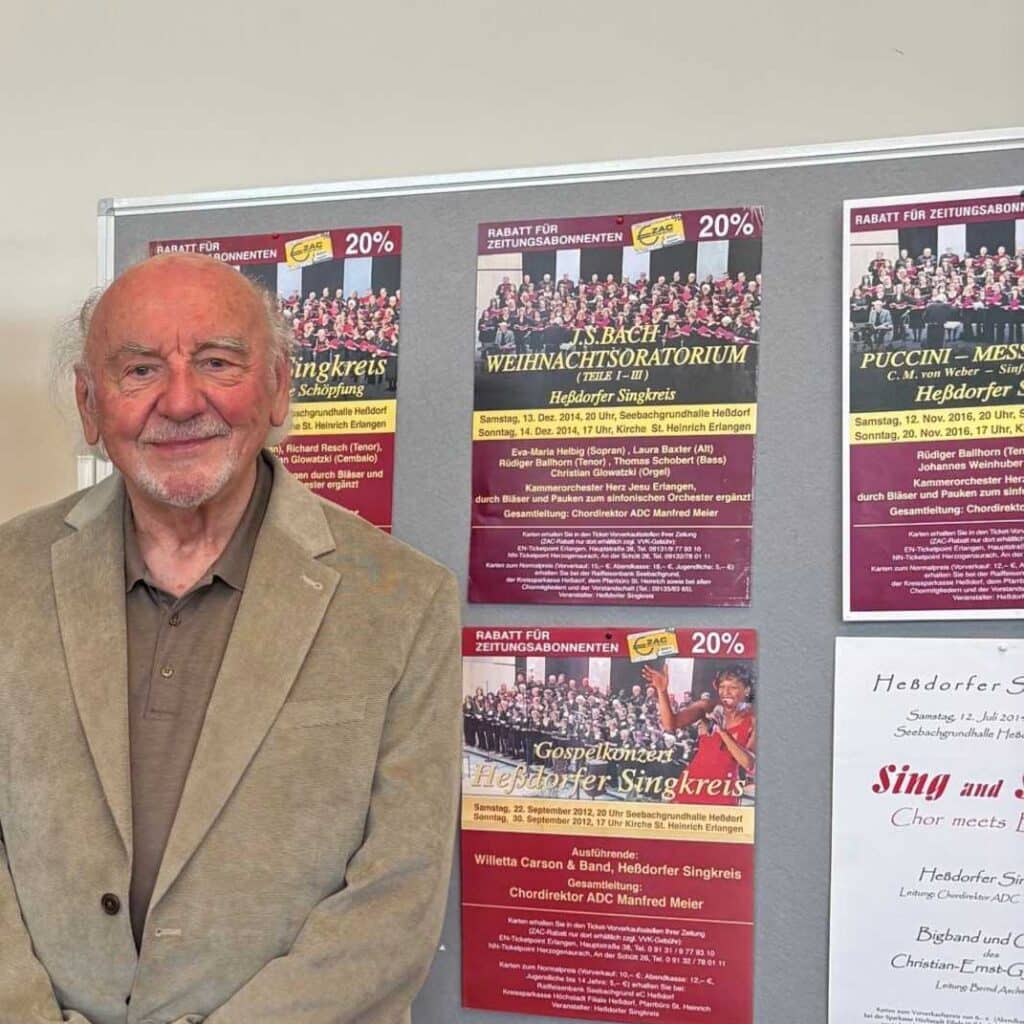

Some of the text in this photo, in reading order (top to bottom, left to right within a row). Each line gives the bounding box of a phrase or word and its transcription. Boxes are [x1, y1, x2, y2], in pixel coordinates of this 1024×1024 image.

[855, 201, 1024, 225] RABATT FÜR ZEITUNGSABONN
[488, 222, 558, 239] RABATT FÜR
[699, 213, 754, 238] 20%
[199, 241, 220, 251] FÜR
[345, 231, 394, 255] 20%
[487, 232, 623, 249] ZEITUNGSABONNENTEN
[213, 249, 276, 263] ABONNENTEN
[486, 346, 748, 372] WEIHNACHTSORATORIUM
[860, 344, 1024, 369] PUCCINI MESS
[290, 354, 387, 381] ingkreis
[945, 368, 980, 377] Weber
[298, 383, 365, 399] Schöpfung
[549, 388, 676, 406] Heßdorfer Singkreis
[916, 382, 1012, 405] Heßdorfer
[480, 414, 520, 425] Samstag,
[586, 412, 596, 420] 20
[619, 409, 710, 422] Seebachgrundhalle
[712, 408, 750, 418] Heßdorf
[855, 417, 902, 427] Samstag,
[923, 414, 946, 424] Nov.
[979, 411, 992, 420] 20
[478, 428, 517, 438] Sonntag,
[583, 425, 593, 434] 17
[616, 424, 647, 433] Kirche
[666, 422, 707, 432] Heinrich
[709, 422, 751, 434] Erlangen
[855, 431, 900, 441] Sonntag,
[920, 427, 944, 437] Nov.
[976, 426, 988, 435] 17
[571, 508, 719, 518] Chordirektor ADC Manfred Meier
[476, 629, 550, 641] RABATT FÜR
[692, 632, 745, 654] 20%
[475, 642, 619, 652] ZEITUNGSABONNENTEN
[873, 674, 1001, 693] Heßdorfer
[893, 726, 994, 740] Seebachgrundhalle
[534, 741, 673, 763] Gospelkonzert
[472, 763, 746, 799] Heßdorfer Singkreis
[872, 764, 1004, 801] Sing and
[528, 806, 743, 822] September 20 Uhr Seebachgrundhalle Heßdorf
[891, 807, 1006, 829] Chor meets
[705, 823, 743, 834] Erlangen
[572, 847, 638, 860] Ausführende:
[475, 854, 742, 881] Willetta Carson & Band, Heßdorfer Singkreis
[919, 866, 997, 885] Heßdorfer
[568, 878, 642, 893] Gesamtleitung:
[509, 887, 704, 910] Chordirektor ADC Manfred Meier
[916, 926, 1010, 946] Bigband und
